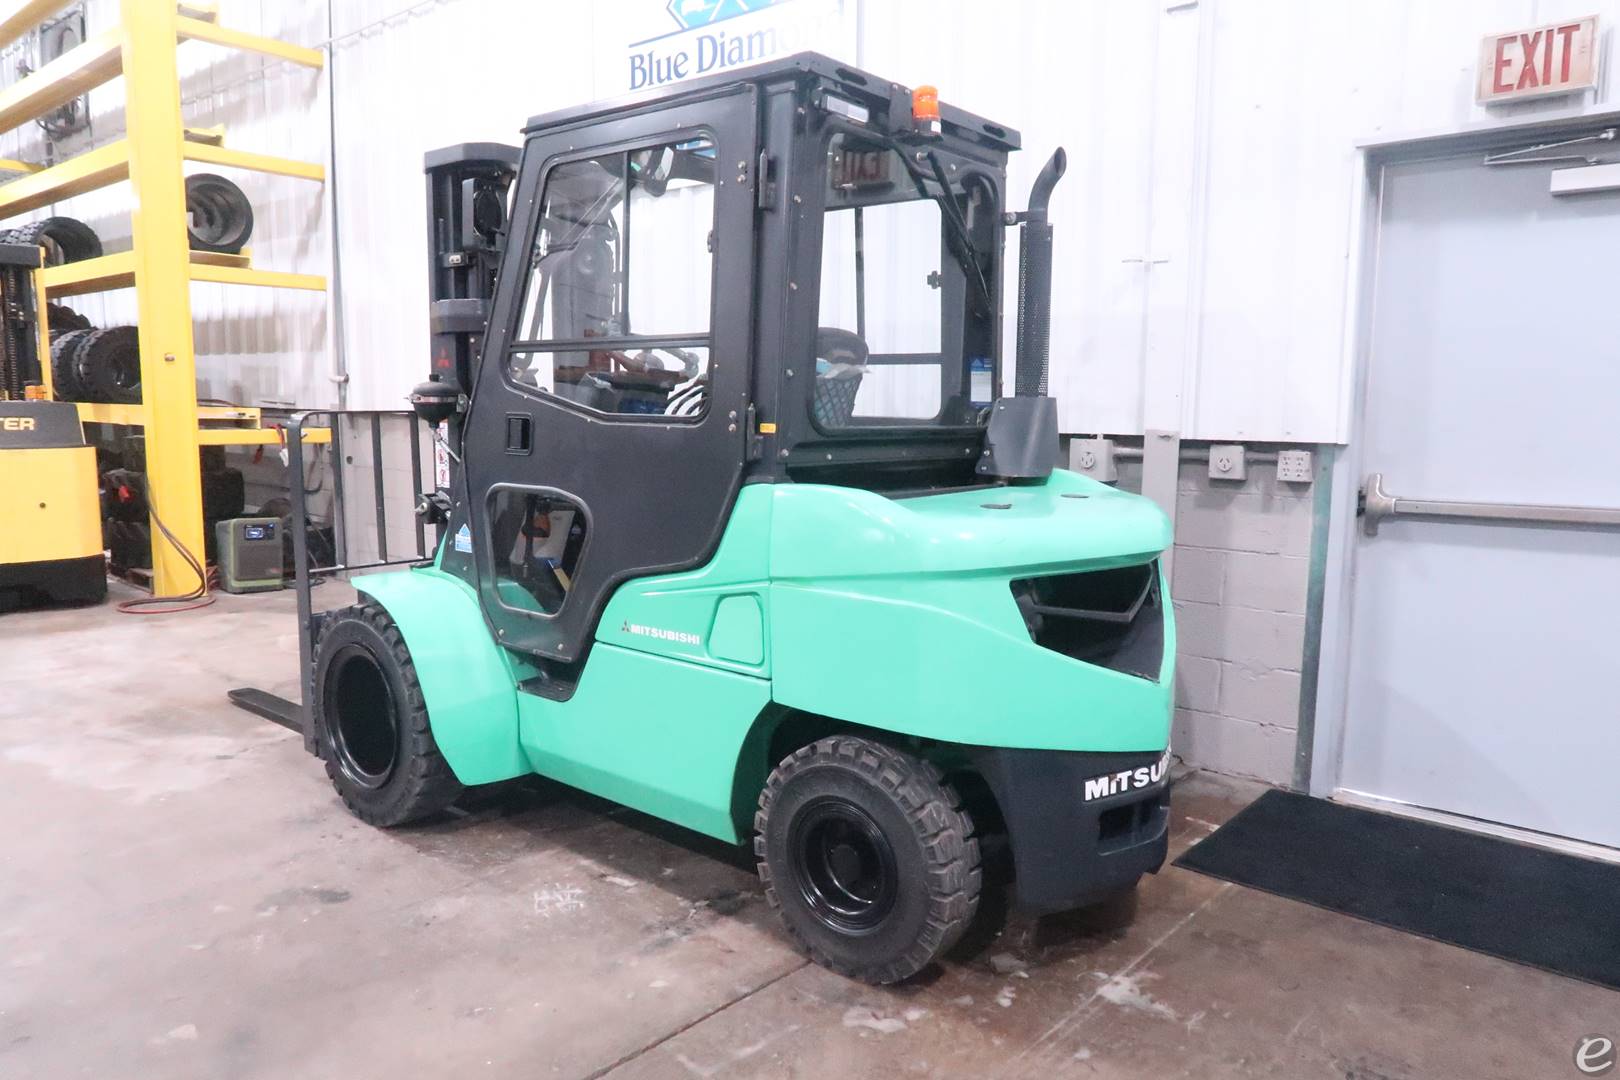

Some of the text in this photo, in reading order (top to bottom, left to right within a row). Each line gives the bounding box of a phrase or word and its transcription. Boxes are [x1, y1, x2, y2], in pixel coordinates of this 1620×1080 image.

[629, 50, 689, 90] Blue
[1493, 24, 1581, 94] EXIT
[631, 624, 700, 645] MITSUBISHI
